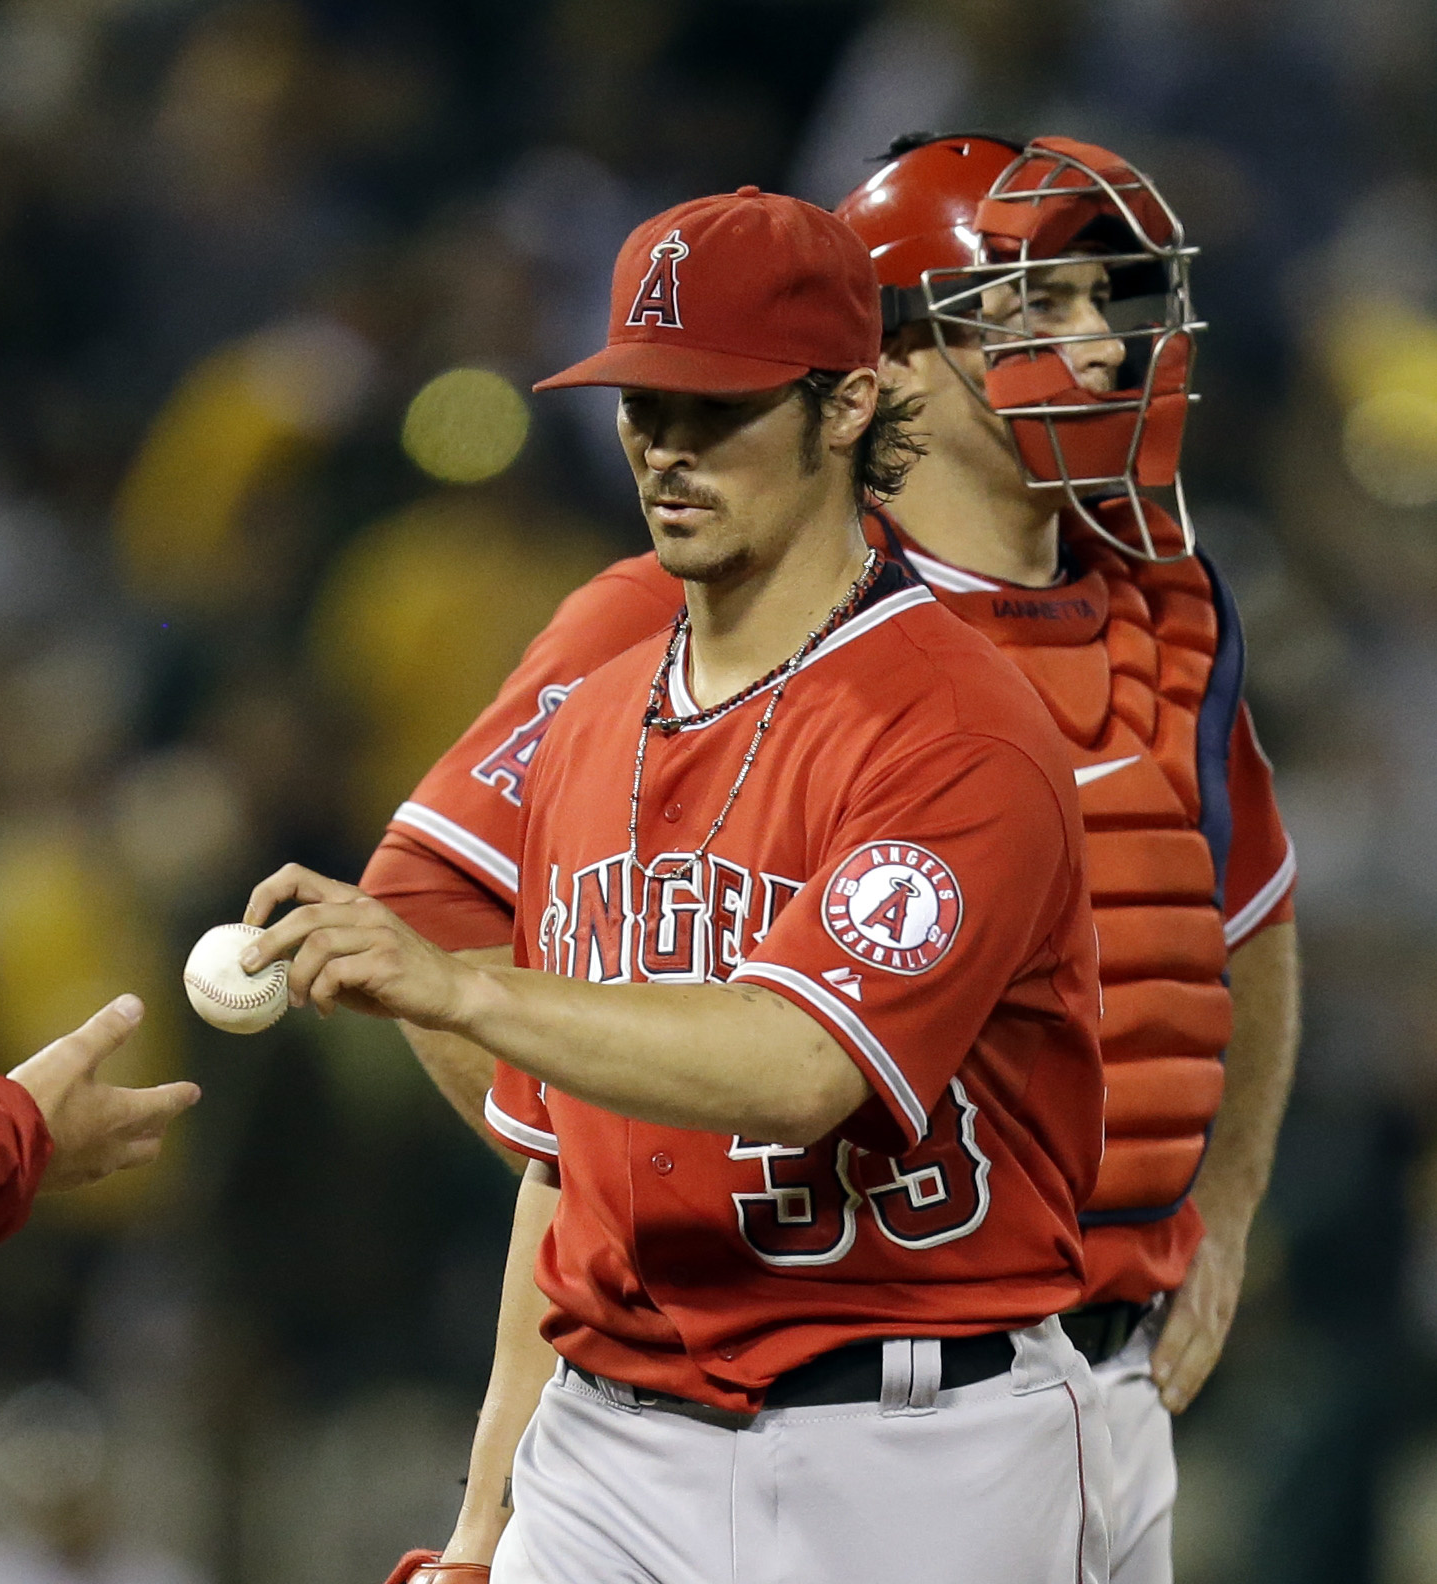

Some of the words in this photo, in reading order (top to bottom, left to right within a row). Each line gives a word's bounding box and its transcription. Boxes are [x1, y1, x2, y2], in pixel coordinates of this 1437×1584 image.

[834, 876, 860, 898] 19
[870, 846, 955, 901] ANGELS
[828, 904, 929, 968] BASEBALL
